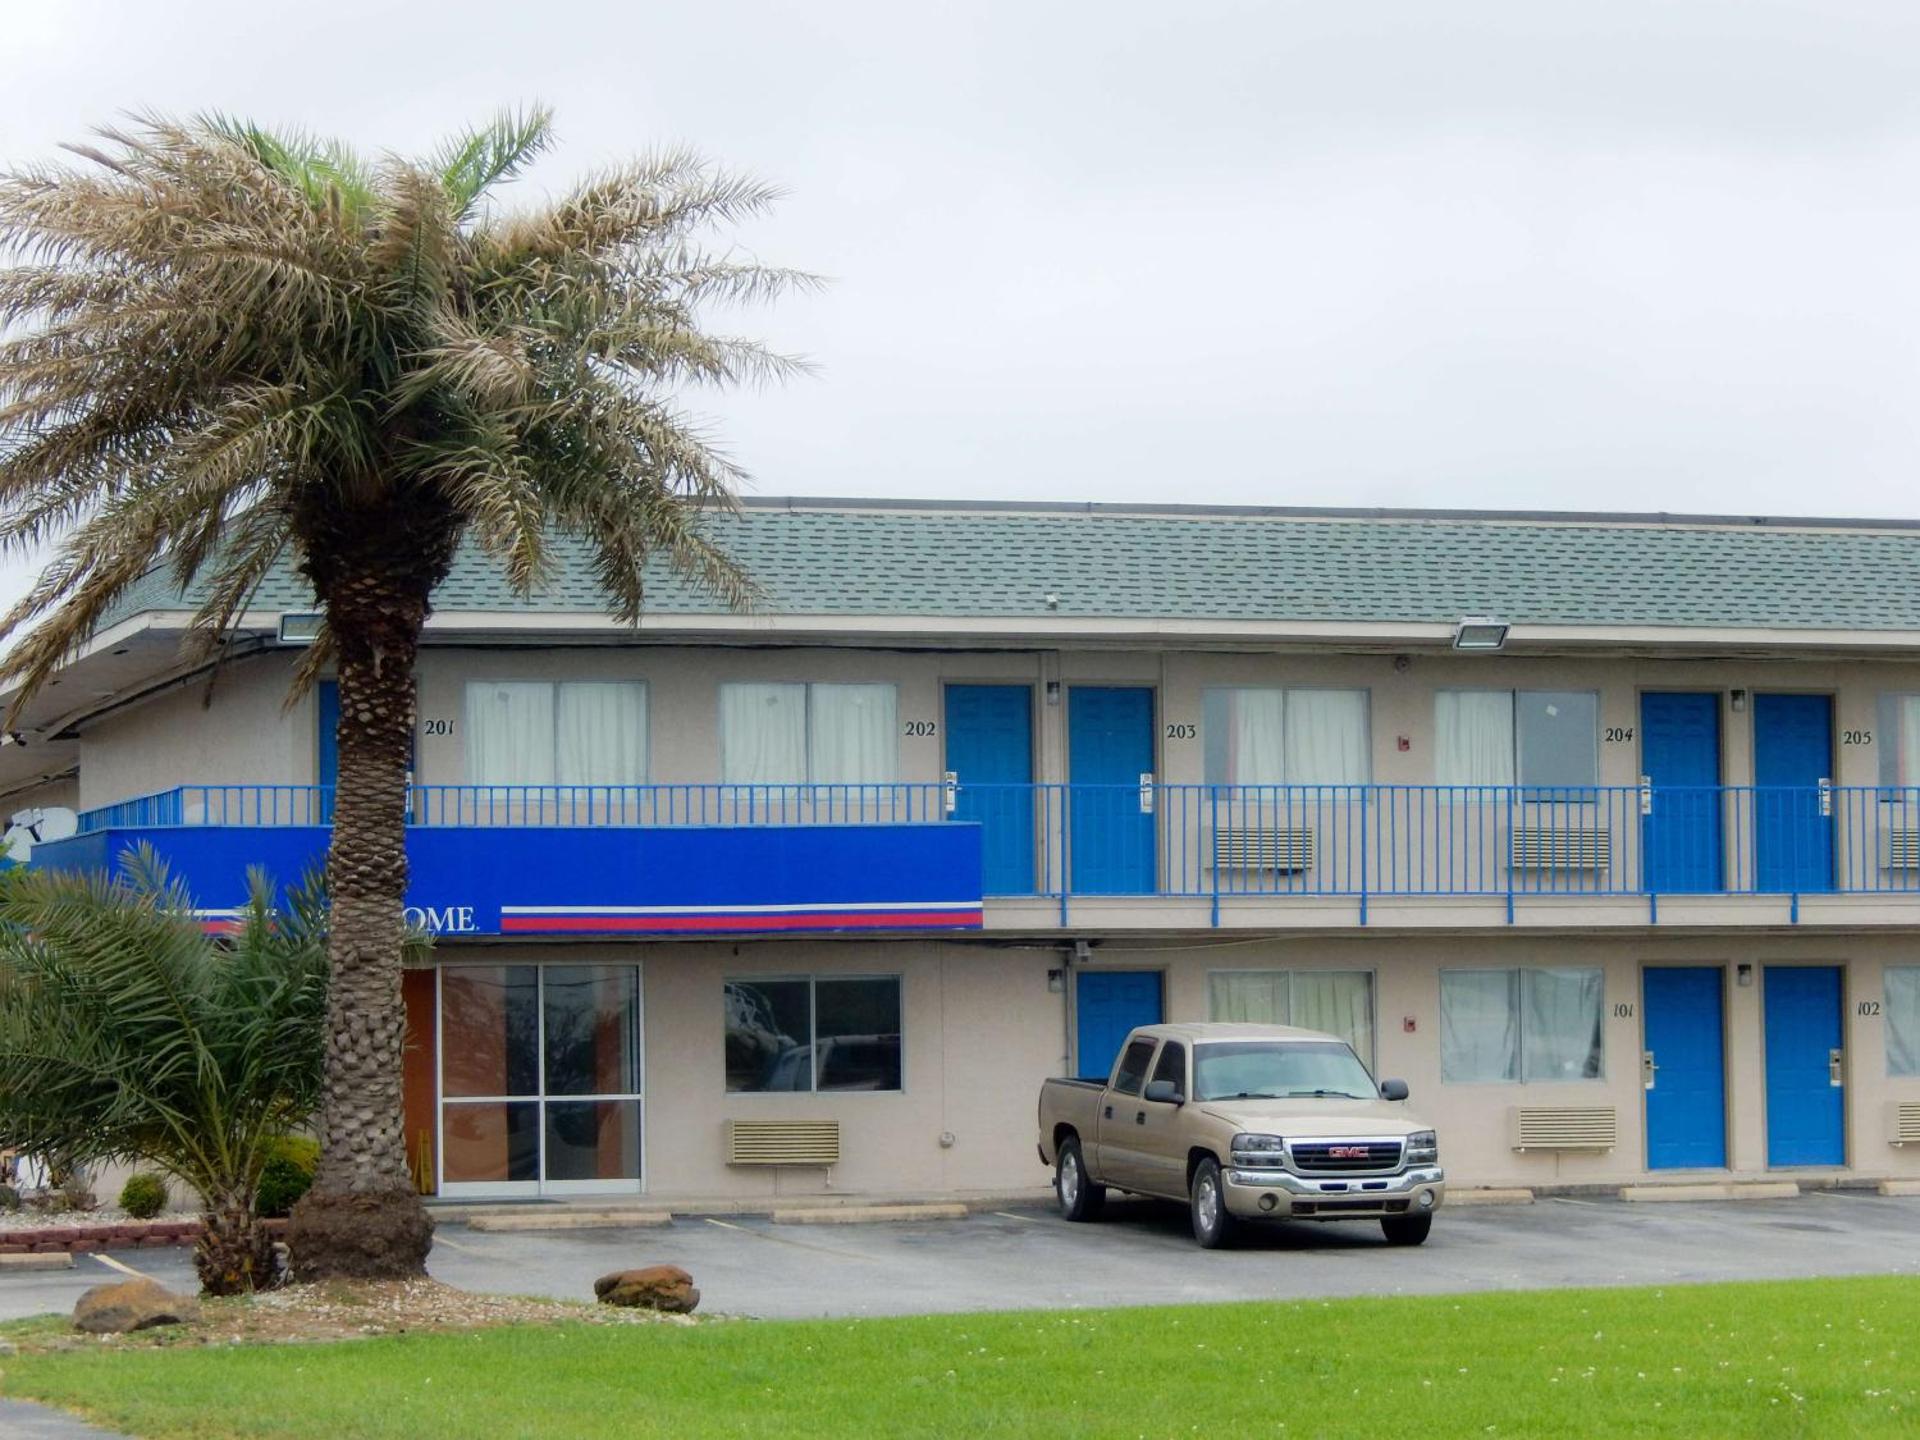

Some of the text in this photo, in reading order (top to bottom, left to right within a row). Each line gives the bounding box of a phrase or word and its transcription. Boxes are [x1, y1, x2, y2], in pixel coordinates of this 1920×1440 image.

[425, 720, 454, 735] 201
[905, 721, 936, 736] 202
[1166, 725, 1196, 739] 203
[1605, 728, 1633, 742] 204
[1843, 731, 1872, 745] 205
[1613, 1003, 1633, 1018] 101
[1857, 1002, 1880, 1016] 102
[1328, 1146, 1369, 1158] GMC
